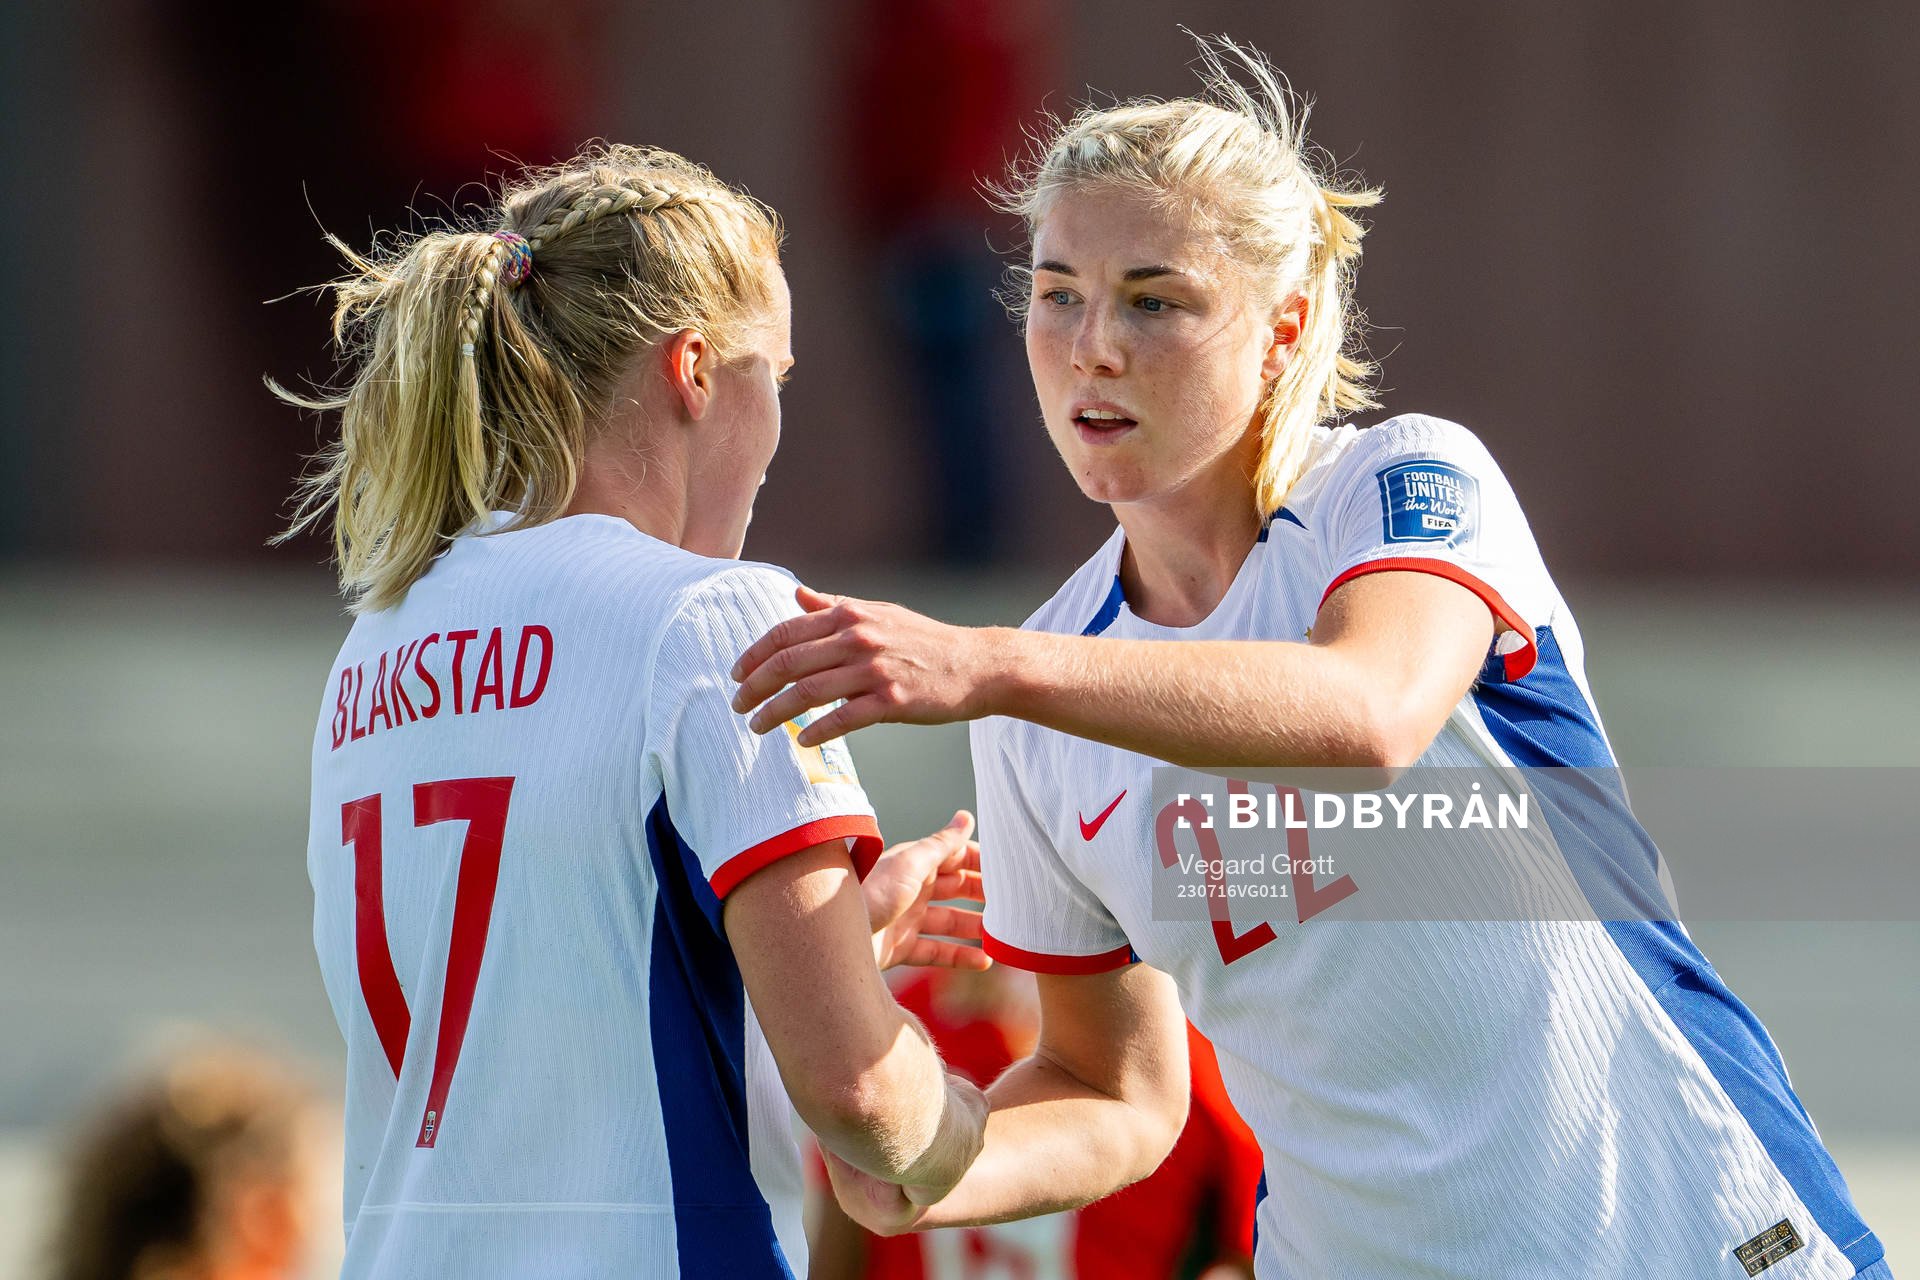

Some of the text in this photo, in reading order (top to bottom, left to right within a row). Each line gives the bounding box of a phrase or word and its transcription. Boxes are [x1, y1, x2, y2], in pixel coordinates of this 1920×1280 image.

[1403, 472, 1463, 491] FOOTBALL
[1403, 497, 1428, 511] the
[1405, 482, 1464, 507] UNITES
[1427, 518, 1453, 528] FIFA
[331, 624, 554, 751] BLAKSTAD
[341, 776, 516, 1148] 17
